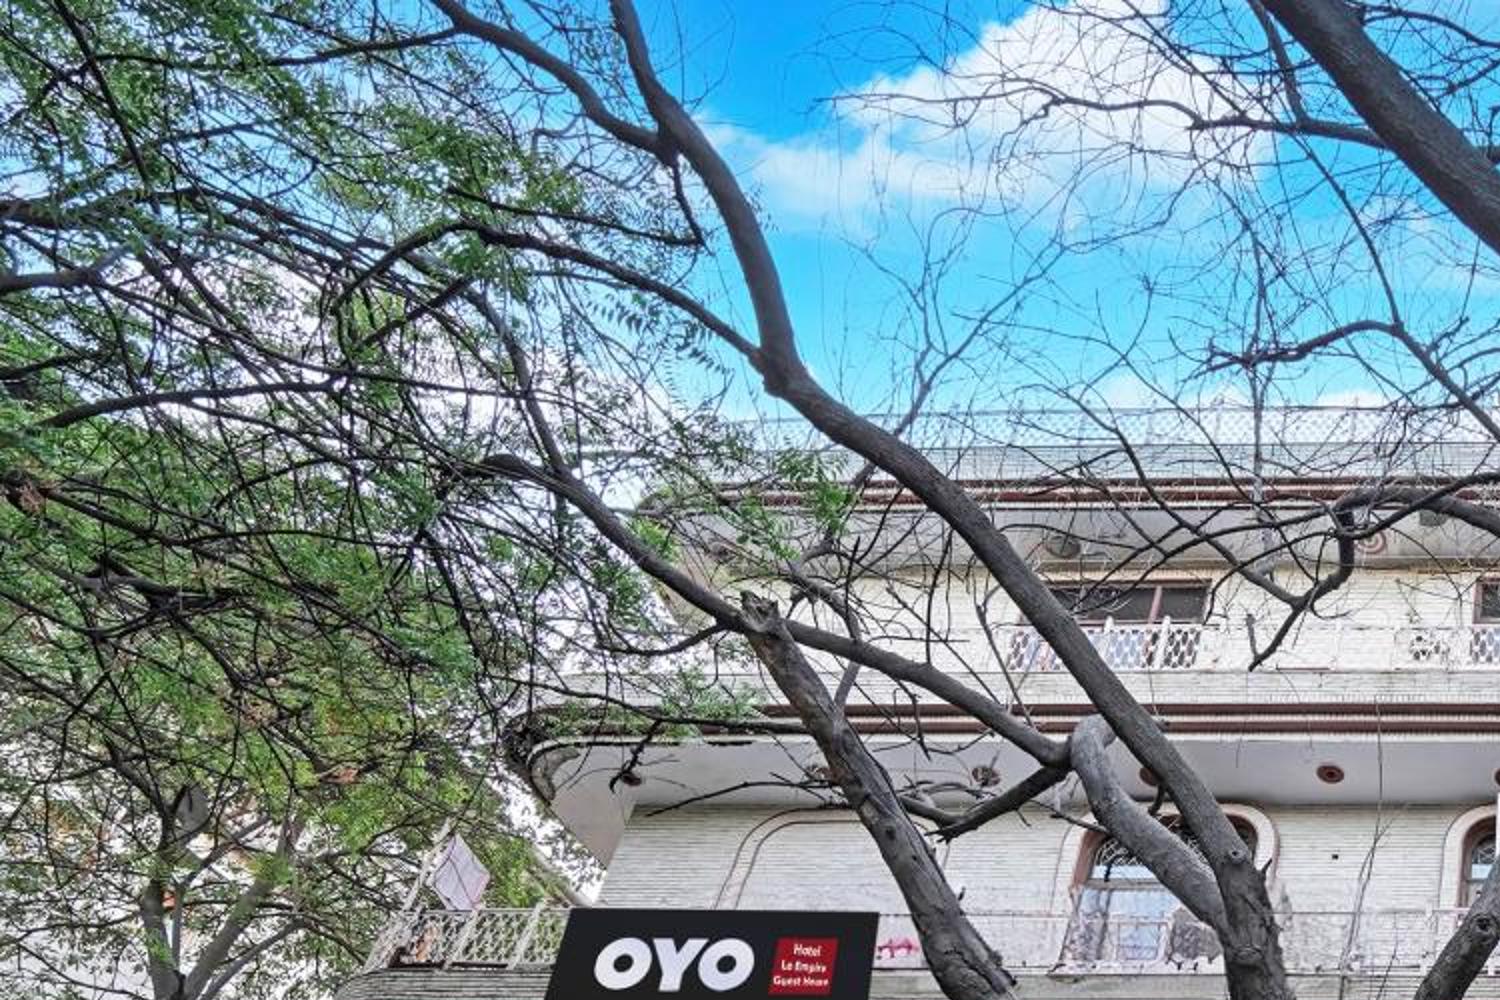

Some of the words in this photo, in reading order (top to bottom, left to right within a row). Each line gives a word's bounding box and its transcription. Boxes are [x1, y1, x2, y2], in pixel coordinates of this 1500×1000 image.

[793, 943, 822, 957] Hotel
[594, 937, 755, 992] OYO
[781, 959, 793, 972] Le
[773, 975, 801, 987] Guest
